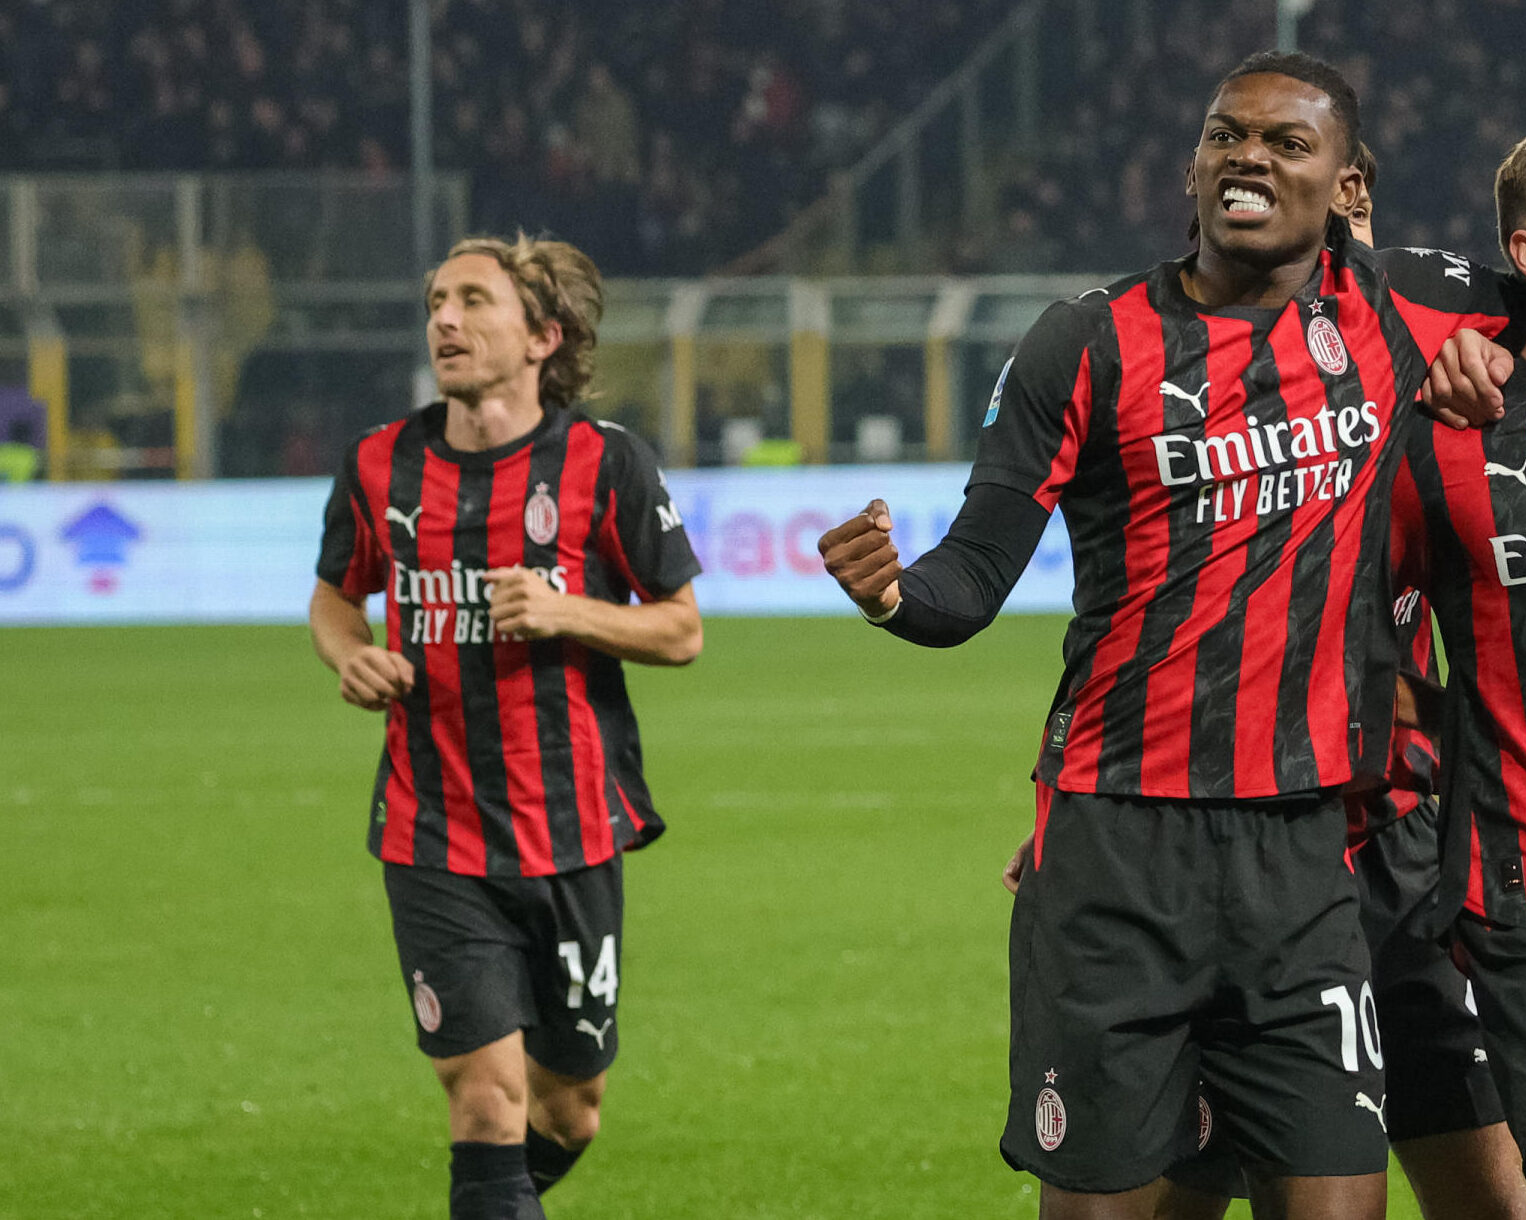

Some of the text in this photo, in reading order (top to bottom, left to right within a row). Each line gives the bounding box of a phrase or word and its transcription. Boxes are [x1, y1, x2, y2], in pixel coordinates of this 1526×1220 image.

[1150, 401, 1381, 486] Emirates
[1196, 458, 1353, 524] FLY BETTER
[393, 559, 568, 604] Emirs
[1393, 589, 1420, 627] TER
[410, 609, 523, 644] FLY BET
[558, 934, 619, 1009] 14
[1320, 980, 1384, 1072] 10
